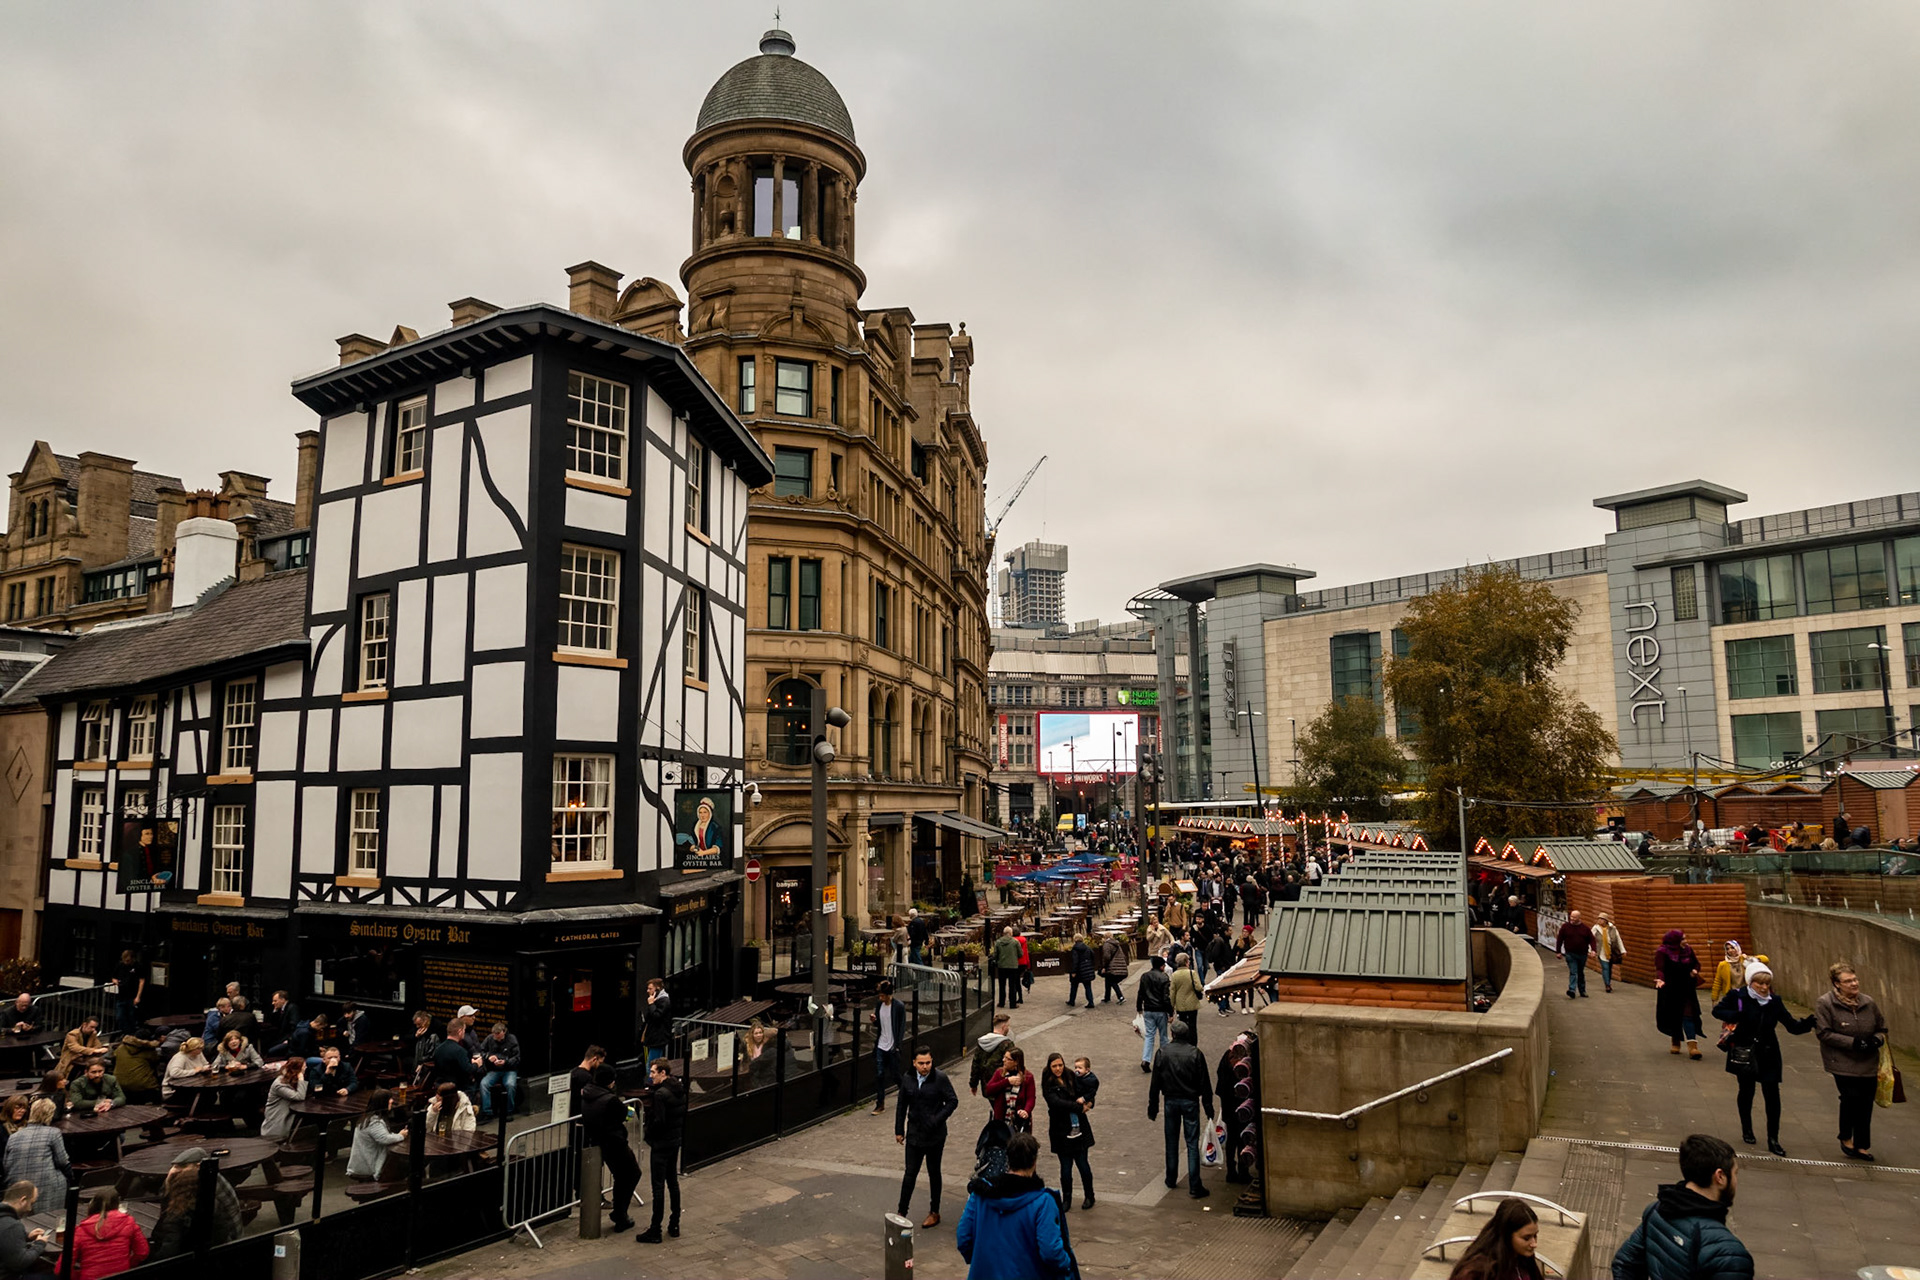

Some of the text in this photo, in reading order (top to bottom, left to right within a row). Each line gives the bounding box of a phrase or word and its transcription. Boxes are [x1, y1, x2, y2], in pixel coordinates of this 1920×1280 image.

[1623, 600, 1666, 725] next
[1223, 649, 1235, 721] next
[1132, 698, 1156, 706] Health
[1770, 760, 1804, 769] COSTA
[682, 859, 723, 868] OYSTER BAR
[126, 884, 151, 892] OYSTER
[775, 880, 799, 888] banyan
[246, 922, 265, 939] Bar
[349, 919, 471, 945] Sinclairs Oyster Bar
[560, 932, 599, 943] CATHEDRAL
[600, 931, 620, 940] GATES
[1036, 960, 1060, 968] banyan
